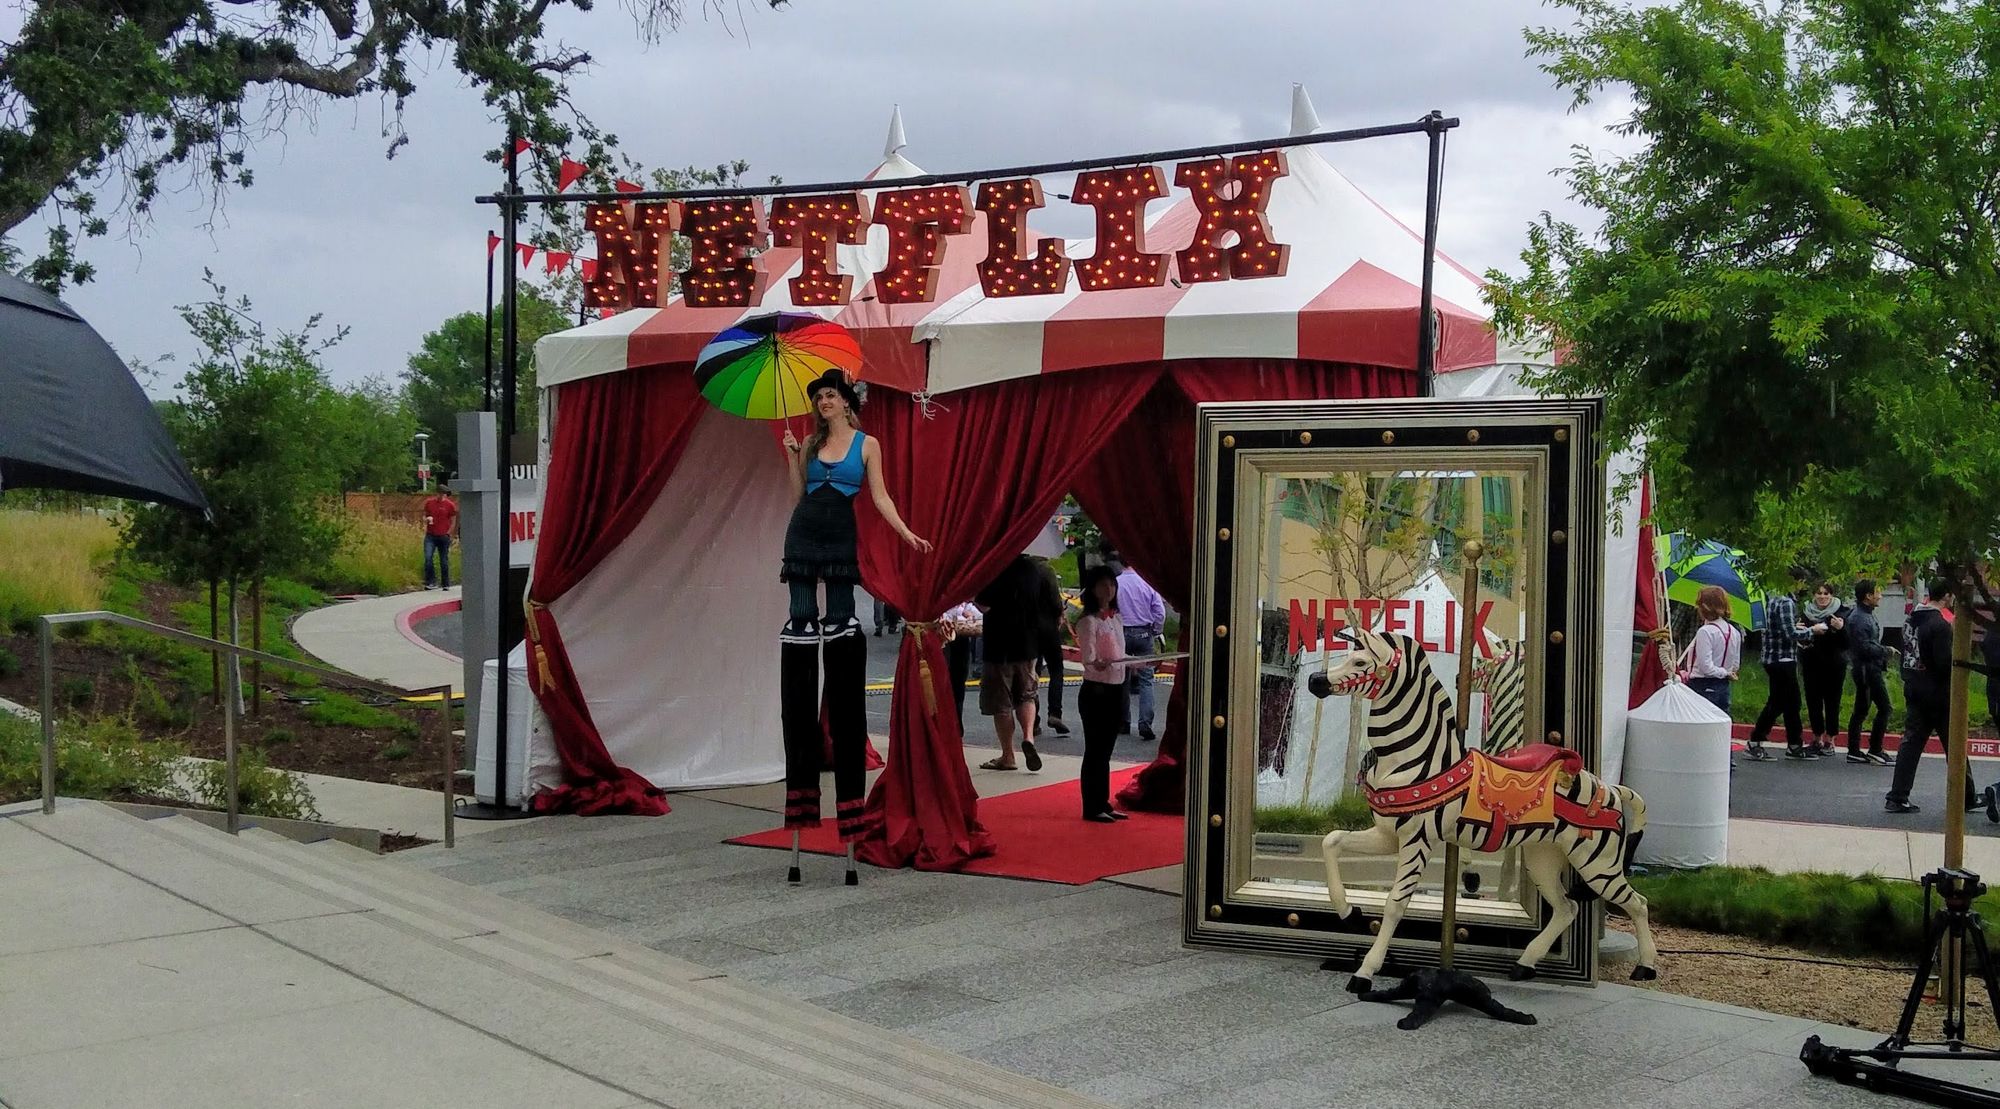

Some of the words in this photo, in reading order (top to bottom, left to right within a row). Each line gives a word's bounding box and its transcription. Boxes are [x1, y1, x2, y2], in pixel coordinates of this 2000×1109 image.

[584, 150, 1291, 308] NETFLIX
[510, 511, 536, 542] NE
[1971, 743, 1995, 754] FIRE
